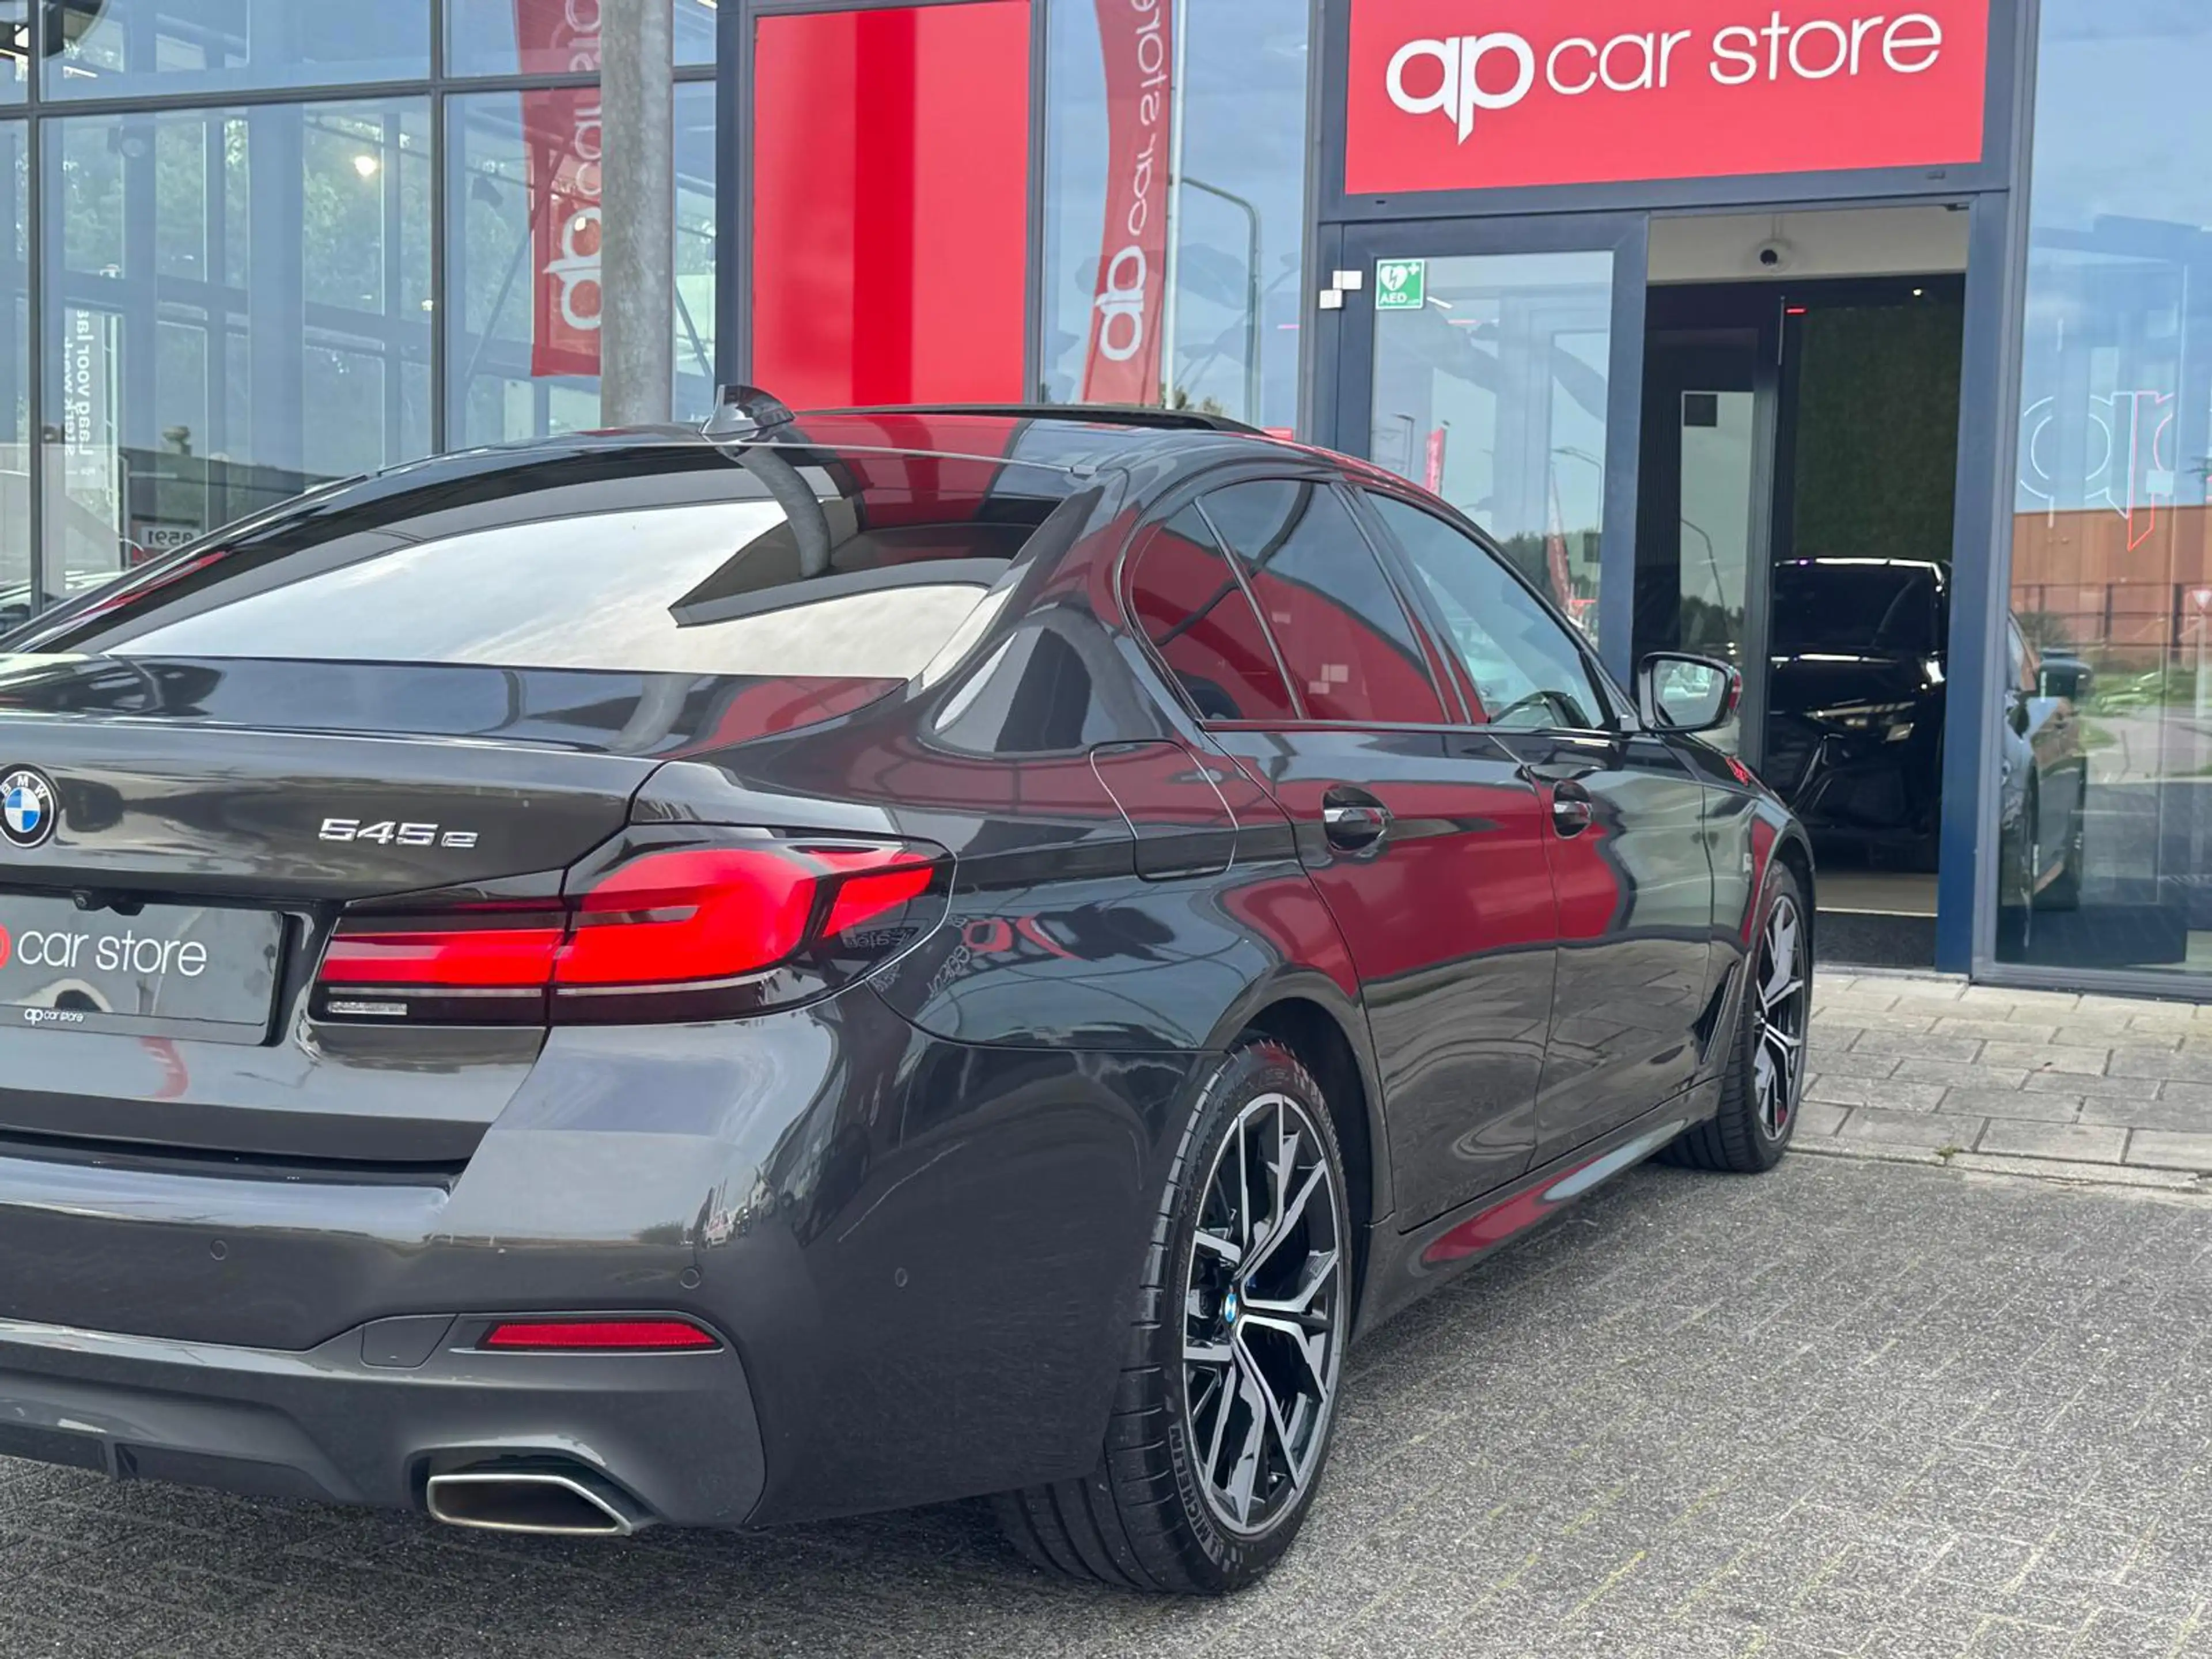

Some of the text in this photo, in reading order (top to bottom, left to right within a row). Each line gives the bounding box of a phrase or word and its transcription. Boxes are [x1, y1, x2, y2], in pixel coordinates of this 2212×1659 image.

[1386, 10, 1942, 146] ap car store
[1379, 291, 1408, 305] AED
[0, 775, 48, 800] BMW
[17, 930, 89, 968] car
[95, 929, 207, 976] store
[44, 1011, 60, 1021] car
[60, 1011, 85, 1023] store
[1169, 1425, 1213, 1544] MICHELIN
